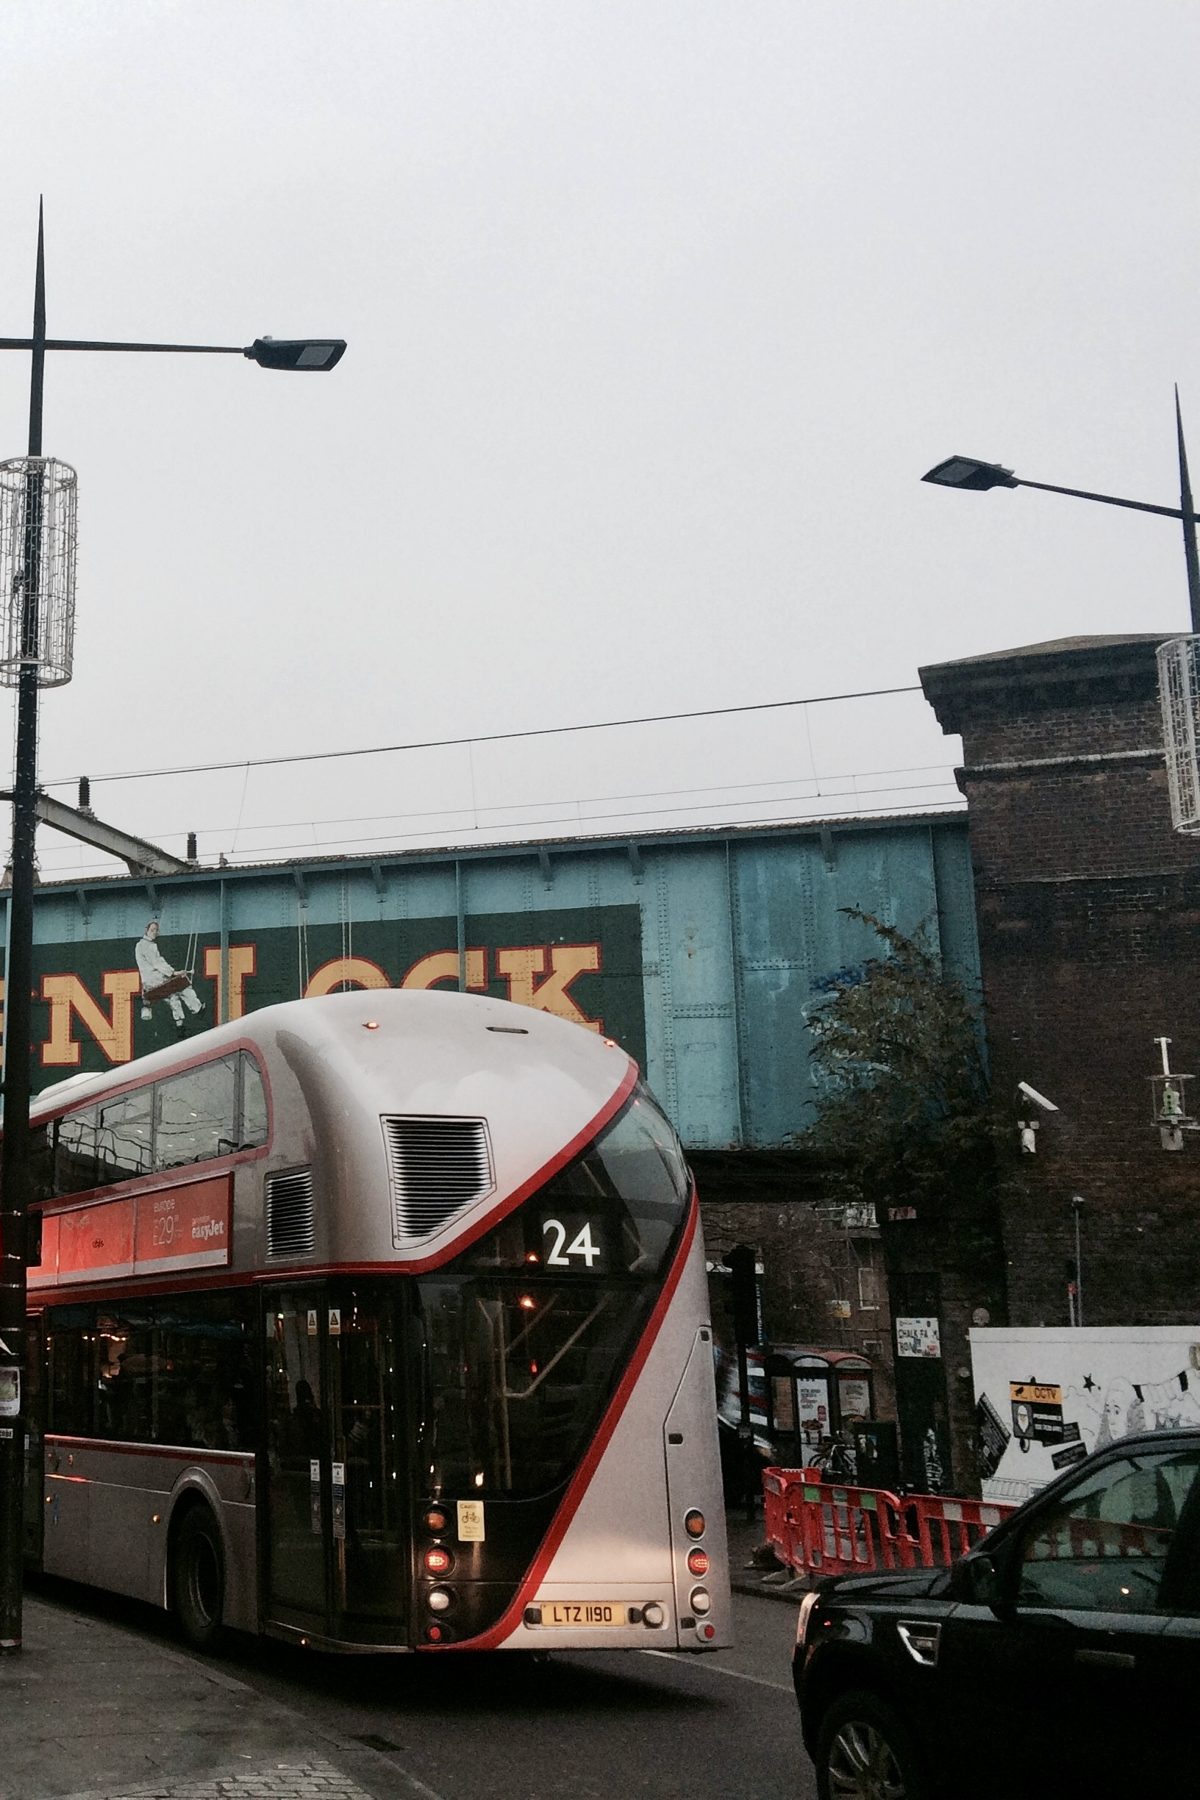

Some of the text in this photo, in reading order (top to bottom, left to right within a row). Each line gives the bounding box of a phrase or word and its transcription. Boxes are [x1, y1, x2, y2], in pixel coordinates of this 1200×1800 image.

[192, 1220, 224, 1240] easyJet
[543, 1219, 601, 1267] 24
[1034, 1387, 1057, 1400] CCTV
[553, 1606, 612, 1623] LTZ 1190
